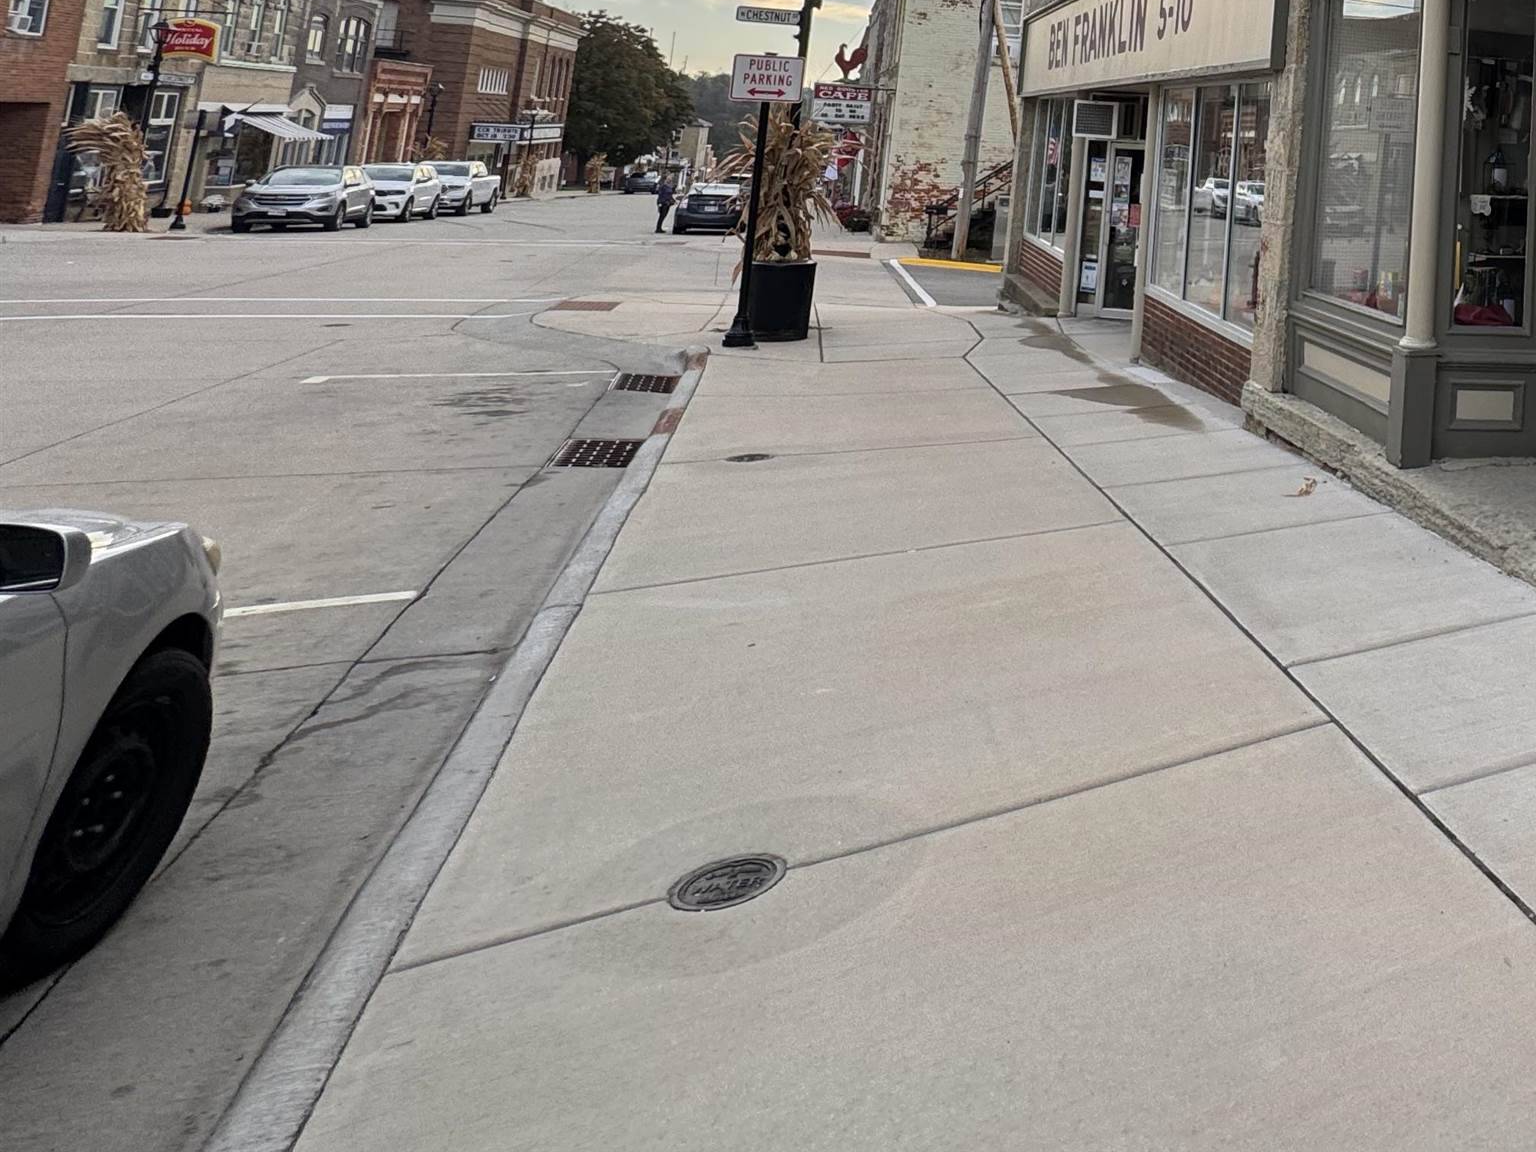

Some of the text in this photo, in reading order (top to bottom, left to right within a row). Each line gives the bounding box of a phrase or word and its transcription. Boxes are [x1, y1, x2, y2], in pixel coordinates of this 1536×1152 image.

[746, 9, 791, 23] CHESTNUT
[1048, 18, 1070, 70] BEN
[749, 59, 790, 73] PUBLIC
[743, 73, 793, 87] PARKING
[819, 90, 869, 101] CAFE
